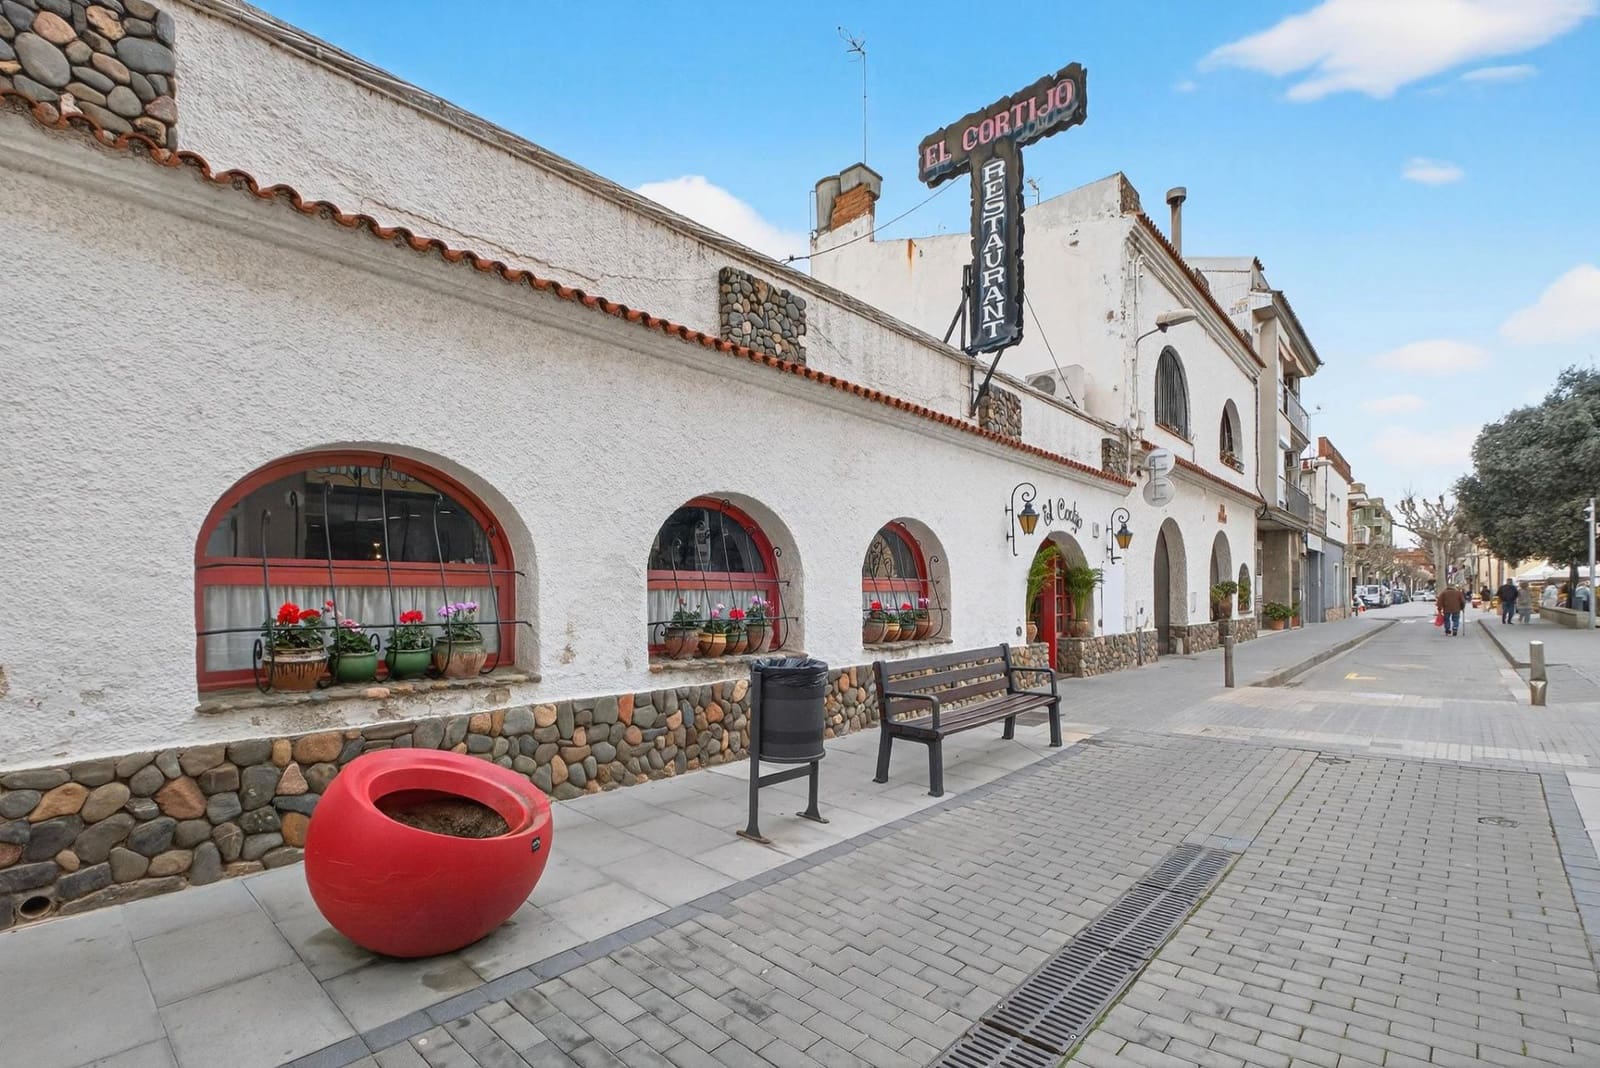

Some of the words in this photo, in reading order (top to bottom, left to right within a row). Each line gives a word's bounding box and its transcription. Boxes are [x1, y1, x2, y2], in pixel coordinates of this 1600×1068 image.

[924, 140, 951, 169] EL
[962, 79, 1074, 151] CORTIJO
[982, 160, 1006, 338] RESTAURANT
